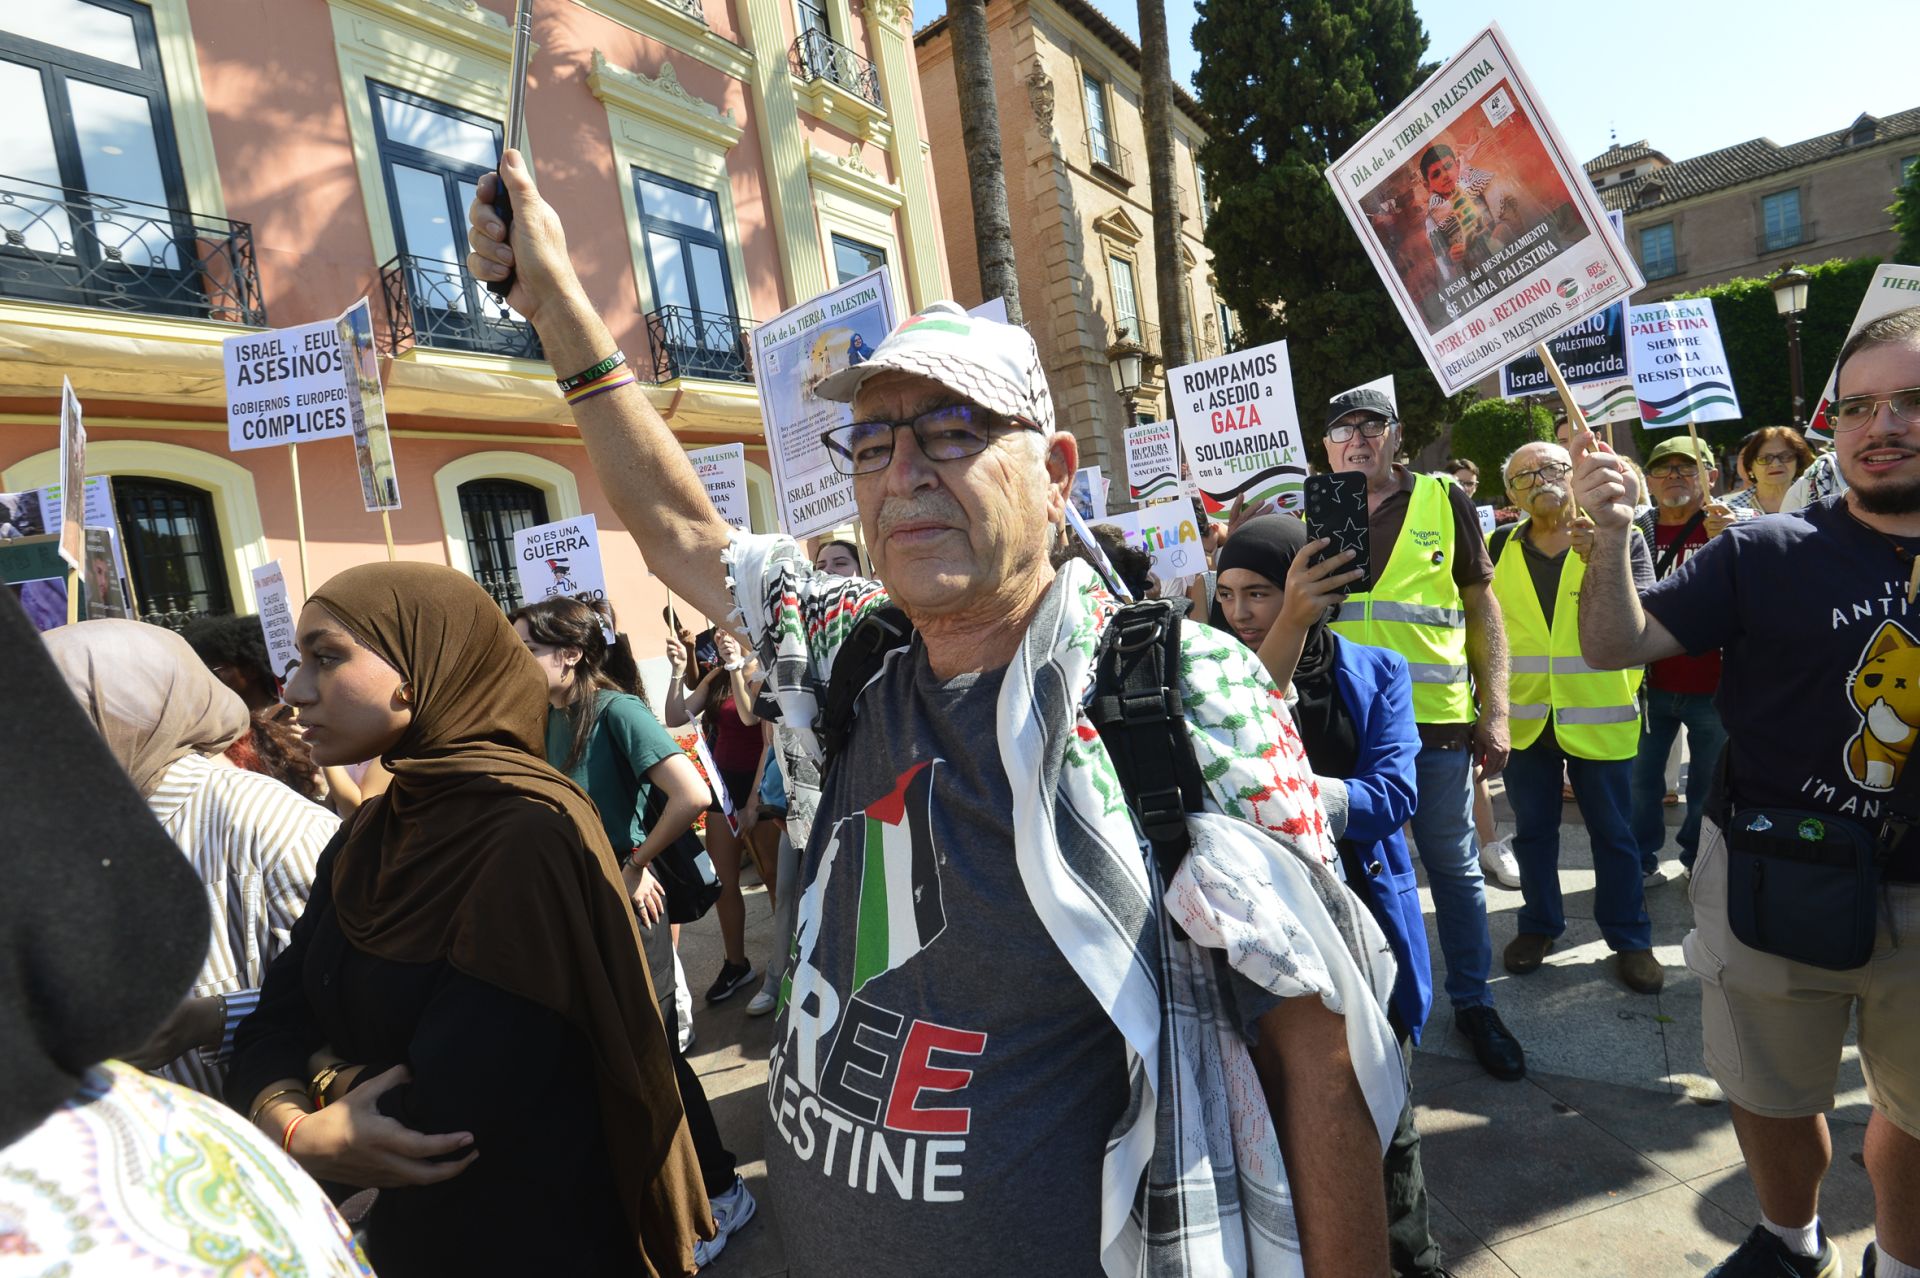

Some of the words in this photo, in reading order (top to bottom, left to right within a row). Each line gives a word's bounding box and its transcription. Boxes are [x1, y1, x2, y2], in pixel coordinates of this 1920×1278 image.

[1350, 165, 1372, 188] DÍA
[1372, 156, 1385, 172] de
[1384, 148, 1396, 161] la
[1392, 112, 1435, 151] TIERRA
[1432, 58, 1495, 119] PALESTINA
[1438, 292, 1445, 302] A
[1445, 276, 1469, 297] PESAR
[1470, 266, 1482, 282] del
[1481, 222, 1549, 273] DESPLAZAMIENTO
[1446, 303, 1462, 318] SE
[1461, 279, 1498, 309] LLAMA
[1498, 239, 1558, 285] PALESTINA
[1565, 275, 1617, 309] samidoun
[763, 329, 777, 348] DÍA
[778, 329, 788, 340] de
[788, 324, 796, 336] la
[797, 308, 827, 330] TIERRA
[830, 287, 878, 317] PALESTINA
[1435, 318, 1486, 358] DERECHO
[1492, 278, 1552, 322] RETORNO
[1631, 318, 1709, 336] PALESTINA
[236, 339, 285, 362] ISRAEL
[1445, 337, 1502, 377] REFUGIADOS
[1502, 302, 1562, 344] PALESTINOS
[1555, 334, 1606, 353] PALESTINOS
[1647, 336, 1702, 351] SIEMPRE
[237, 348, 343, 387] ASESINOS
[1655, 353, 1682, 365] CON
[1685, 351, 1700, 361] LA
[1183, 353, 1277, 394] ROMPAMOS
[1510, 367, 1549, 388] Israel
[1558, 354, 1624, 379] Genocida
[1637, 365, 1724, 384] RESISTENCIA
[232, 396, 290, 415] GOBIERNOS
[1193, 398, 1205, 413] el
[1209, 382, 1260, 410] ASEDIO
[1265, 386, 1273, 397] a
[243, 407, 346, 440] CÓMPLICES
[1211, 404, 1262, 434] GAZA
[1129, 425, 1169, 438] CARTAGENA
[1130, 432, 1170, 446] PALESTINA
[704, 451, 739, 464] PALESTINA
[1132, 443, 1168, 457] RUPTURA
[1195, 430, 1289, 462] SOLIDARIDAD
[699, 464, 717, 473] 2024
[1134, 465, 1170, 477] SANCIONES
[1199, 468, 1213, 478] con
[1214, 466, 1222, 476] la
[787, 482, 816, 504] ISRAEL
[793, 490, 845, 524] SANCIONES
[527, 534, 541, 545] NO
[544, 531, 556, 540] ES
[559, 526, 580, 537] UNA
[523, 536, 590, 561] GUERRA
[546, 586, 558, 596] ES
[563, 582, 577, 592] UN
[1801, 775, 1836, 803] I'M
